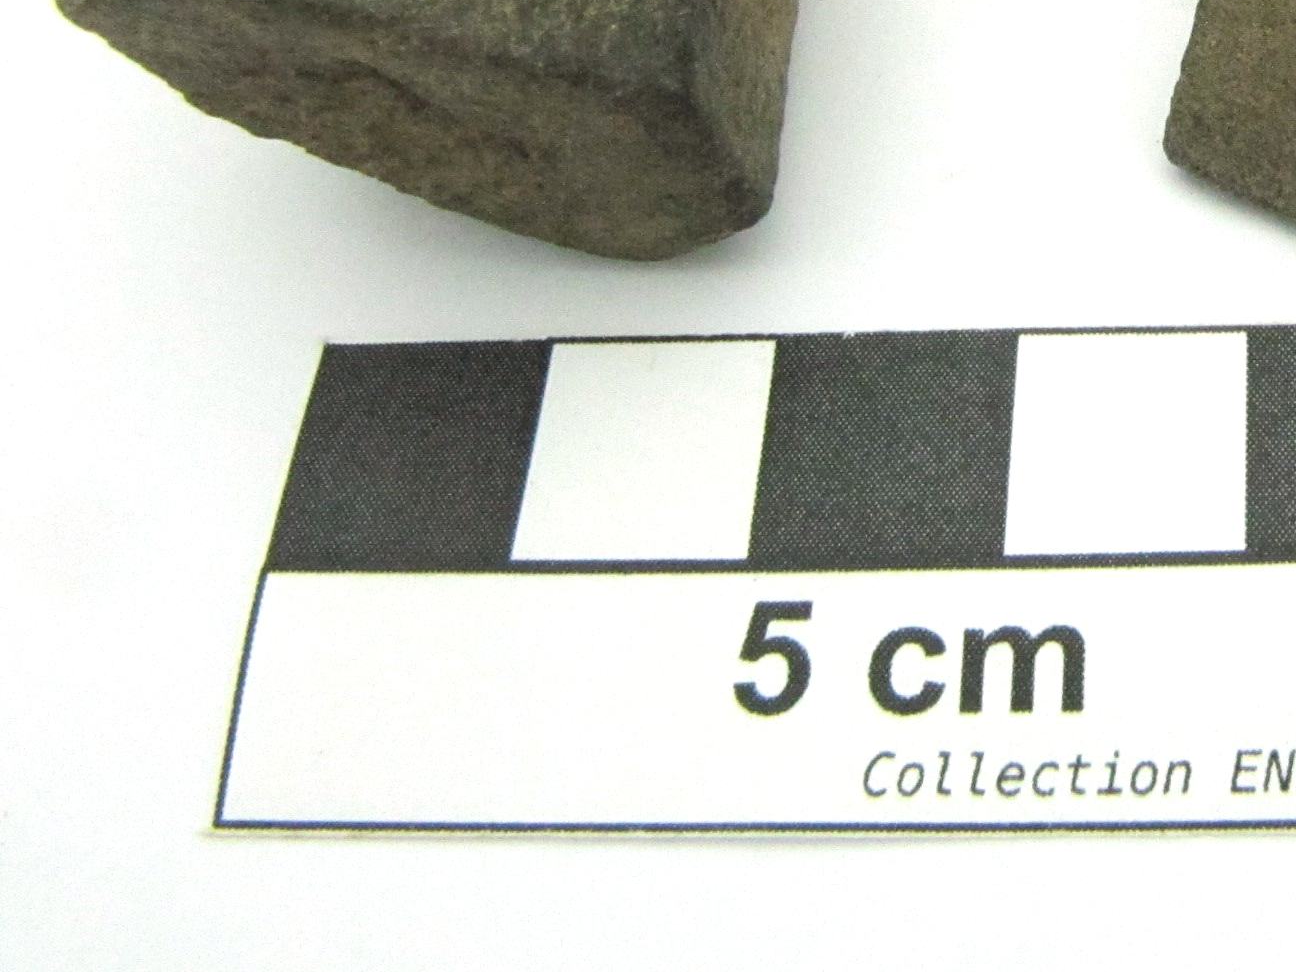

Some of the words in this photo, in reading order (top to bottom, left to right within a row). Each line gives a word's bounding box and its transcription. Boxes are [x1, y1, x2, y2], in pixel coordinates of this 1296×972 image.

[733, 601, 813, 718] 5
[868, 626, 1087, 716] cm
[863, 751, 1192, 799] Collection
